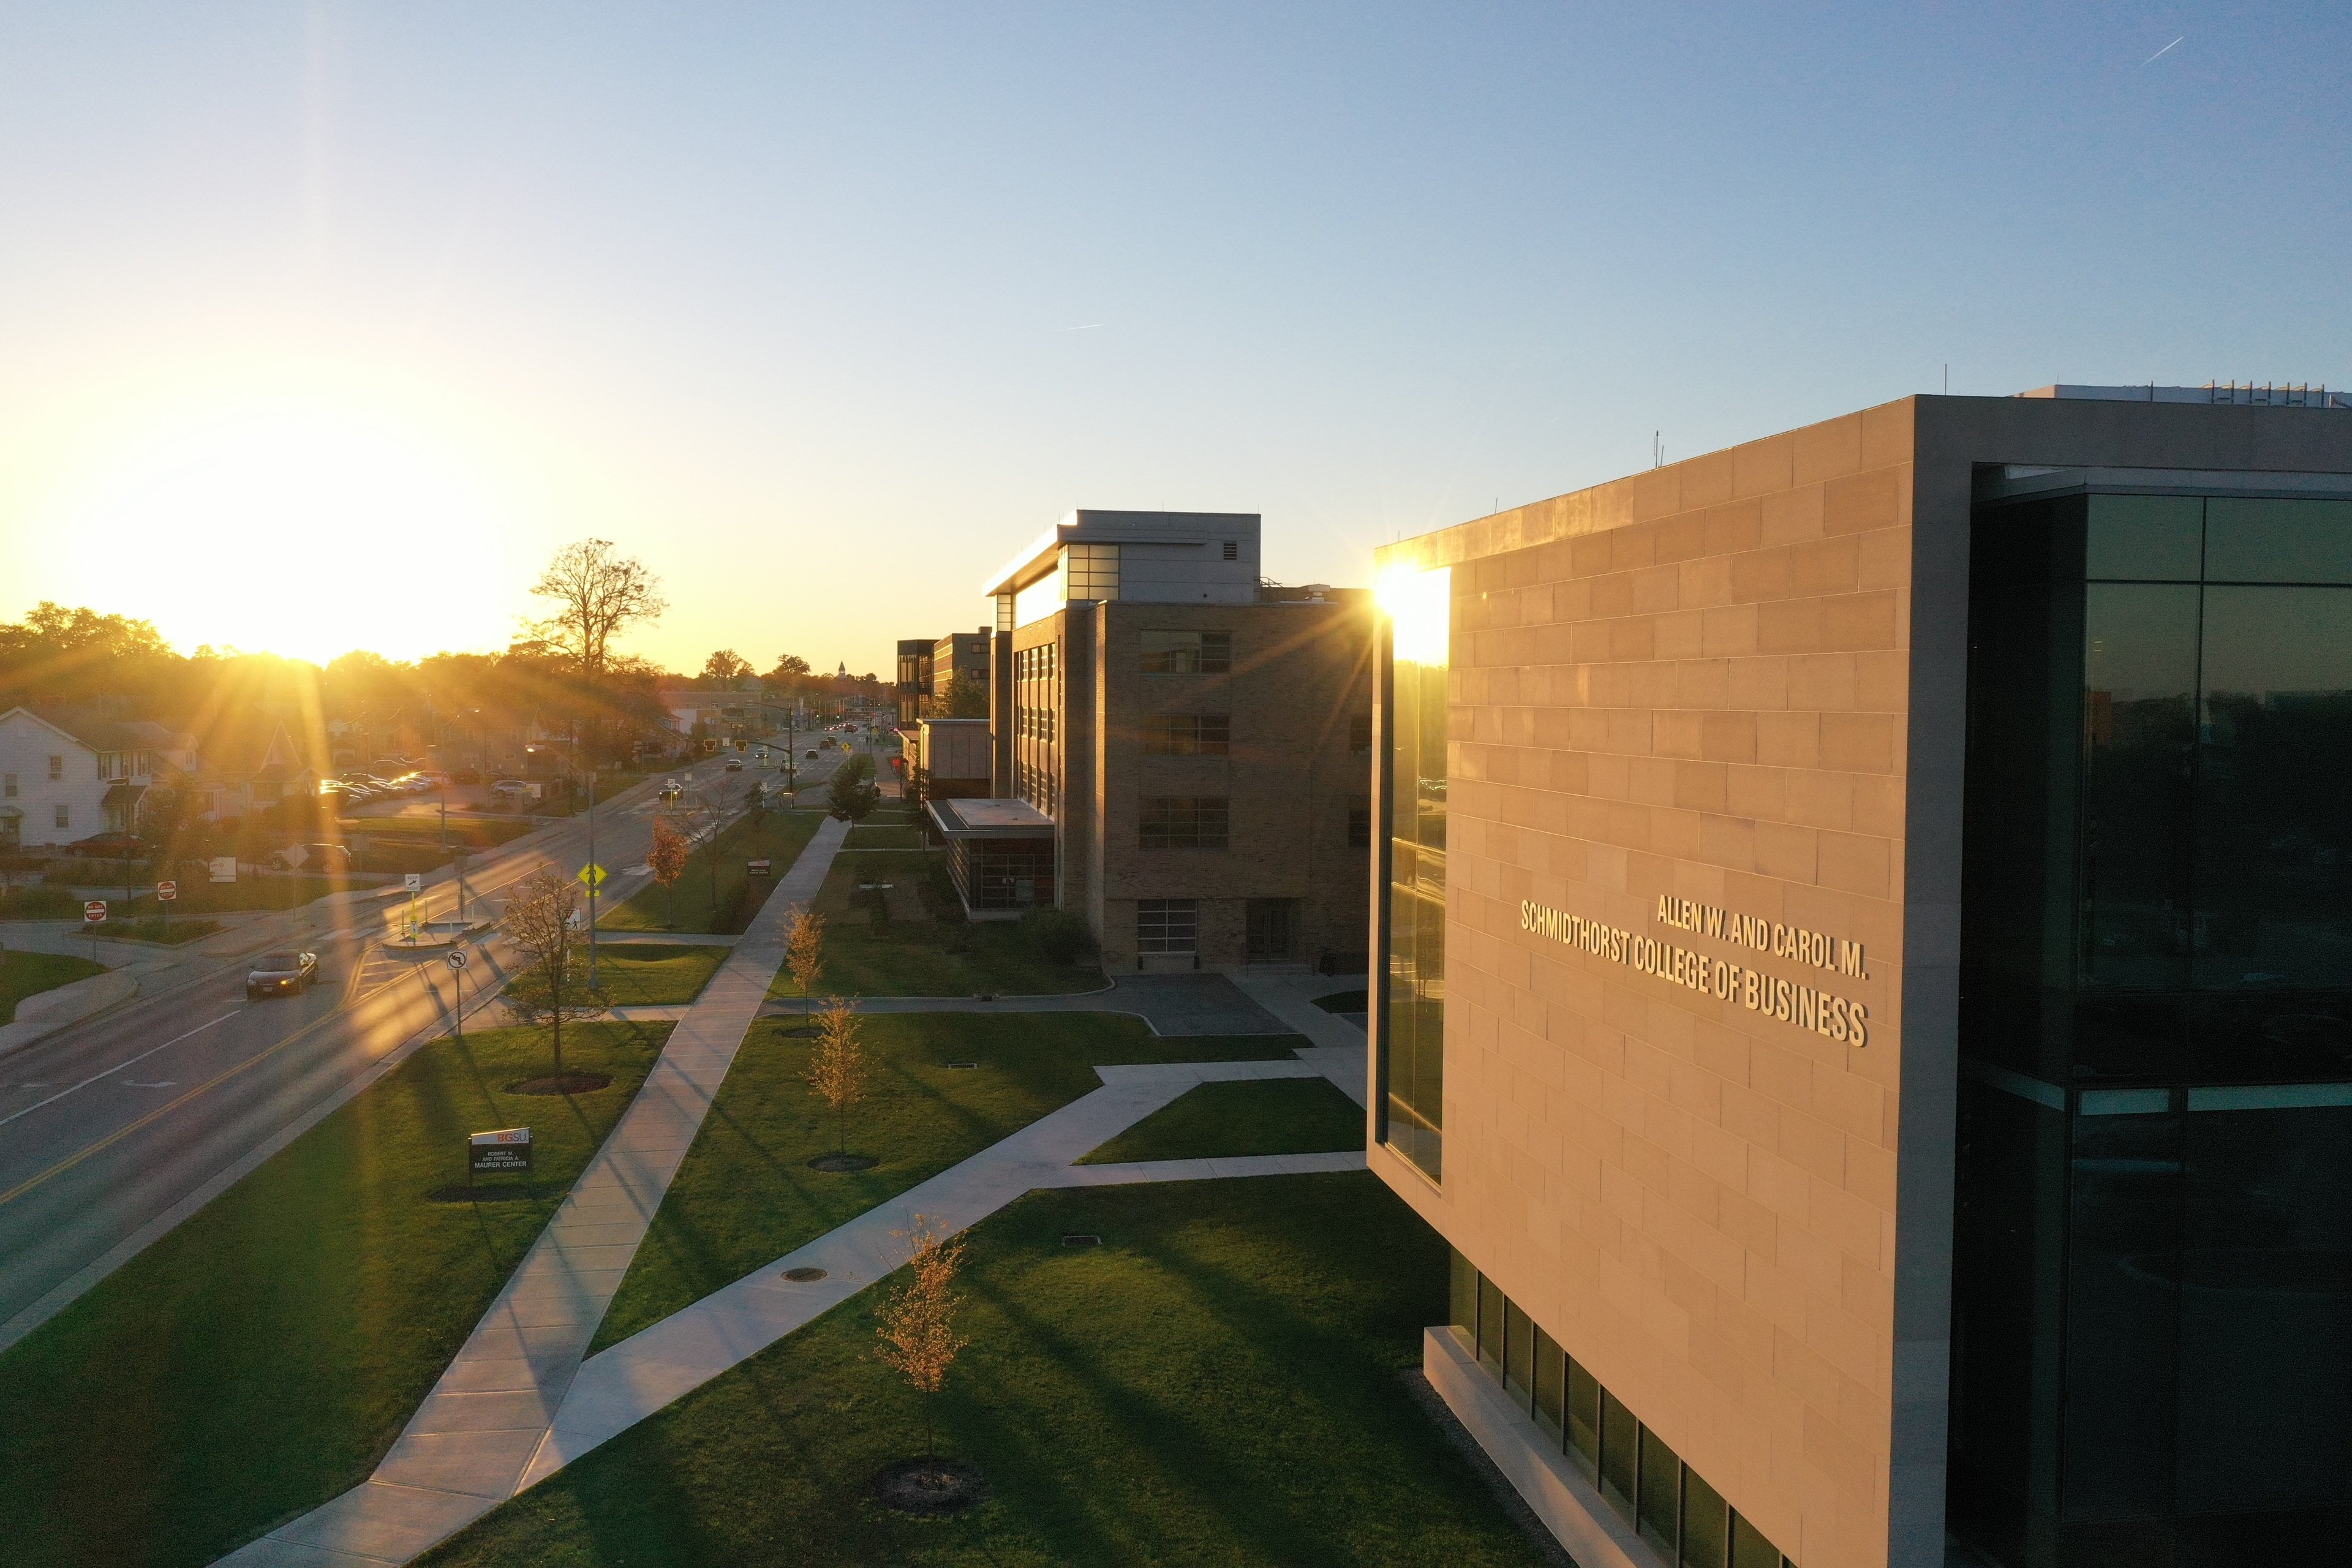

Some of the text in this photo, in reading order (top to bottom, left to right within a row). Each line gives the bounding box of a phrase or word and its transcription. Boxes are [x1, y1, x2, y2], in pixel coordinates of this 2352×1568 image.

[1521, 899, 1866, 1047] SCHMIDTHORST COLLEGE OF BUSINESS
[1657, 894, 1867, 979] ALLEN W. AND CAROL M.
[497, 1133, 526, 1142] BGSU
